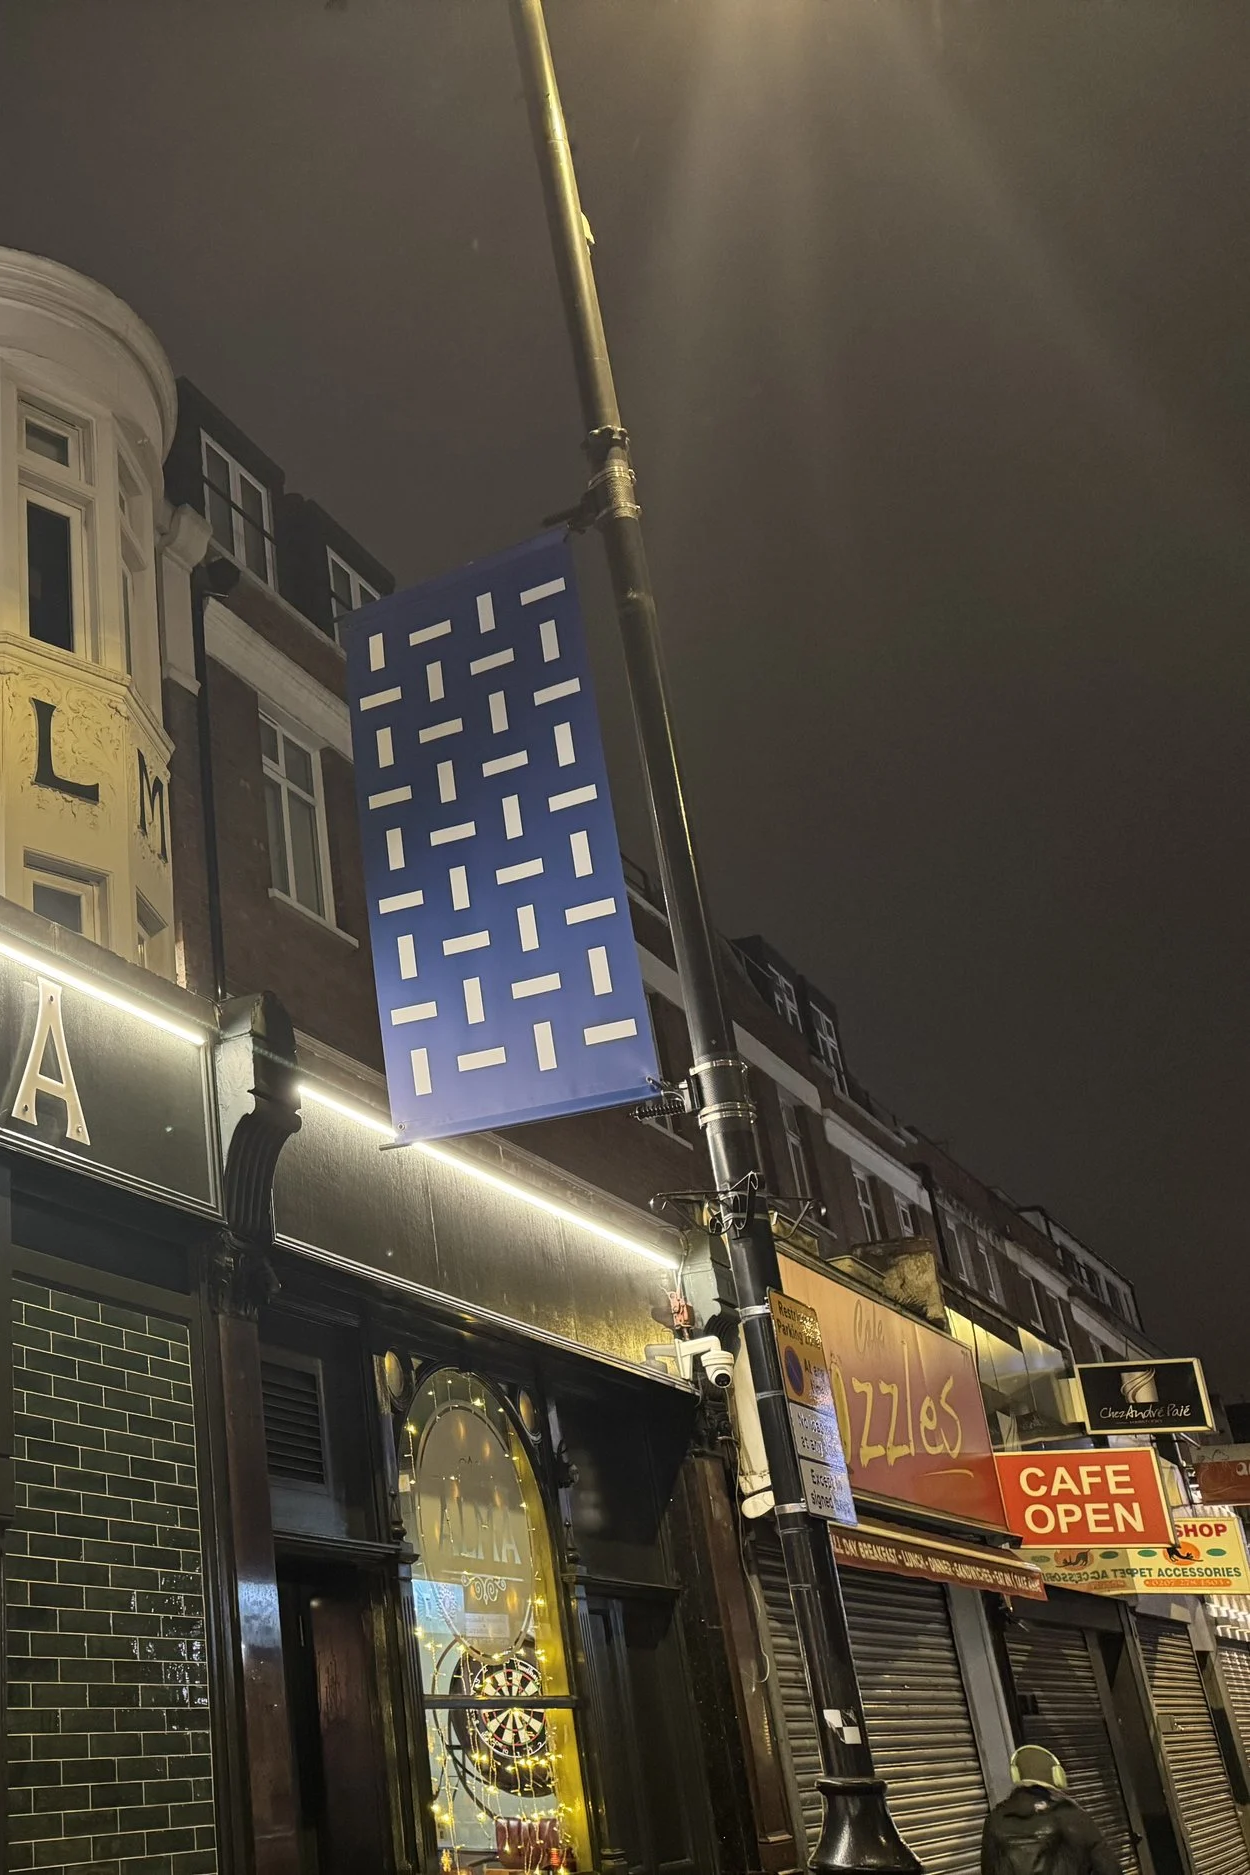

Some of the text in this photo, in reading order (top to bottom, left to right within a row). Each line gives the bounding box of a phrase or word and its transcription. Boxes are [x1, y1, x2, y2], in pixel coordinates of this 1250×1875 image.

[1019, 1464, 1135, 1497] CAFE
[439, 1490, 522, 1566] ALMA
[1024, 1502, 1145, 1534] OPEN
[1175, 1523, 1228, 1538] SHOP
[831, 1534, 845, 1554] LL
[842, 1538, 859, 1558] DAY
[858, 1541, 899, 1565] BREAKFAST
[900, 1549, 927, 1570] LUNCH
[928, 1556, 955, 1576] DINNER
[956, 1562, 994, 1584] SANDWICHES
[1131, 1567, 1242, 1578] PET ACCESSORIES
